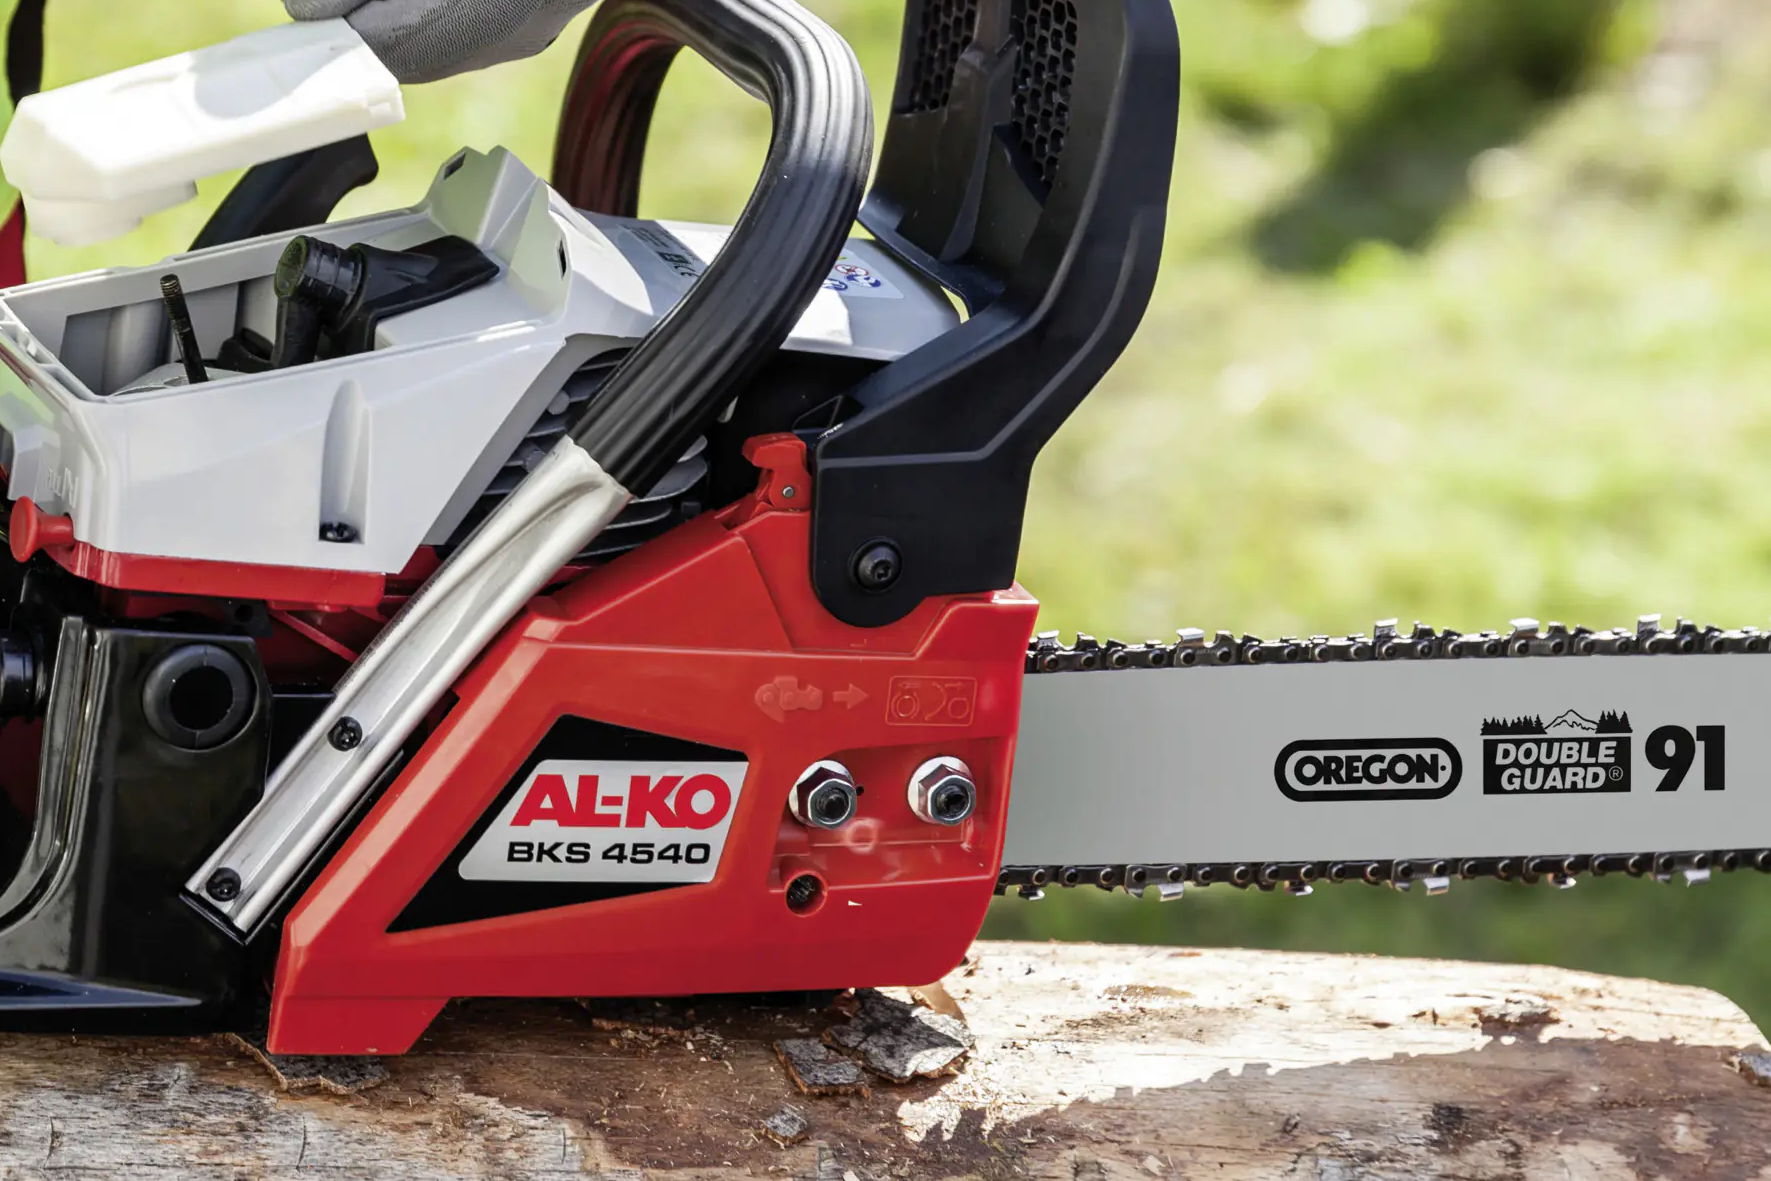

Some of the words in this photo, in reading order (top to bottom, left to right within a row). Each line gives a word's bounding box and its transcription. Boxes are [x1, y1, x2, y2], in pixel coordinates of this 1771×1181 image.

[1293, 753, 1441, 786] OREGON
[1495, 740, 1618, 766] DOUBLE
[1644, 724, 1726, 792] 91
[509, 773, 733, 830] AL-KO
[506, 841, 591, 864] BKS
[601, 841, 712, 865] 4540
